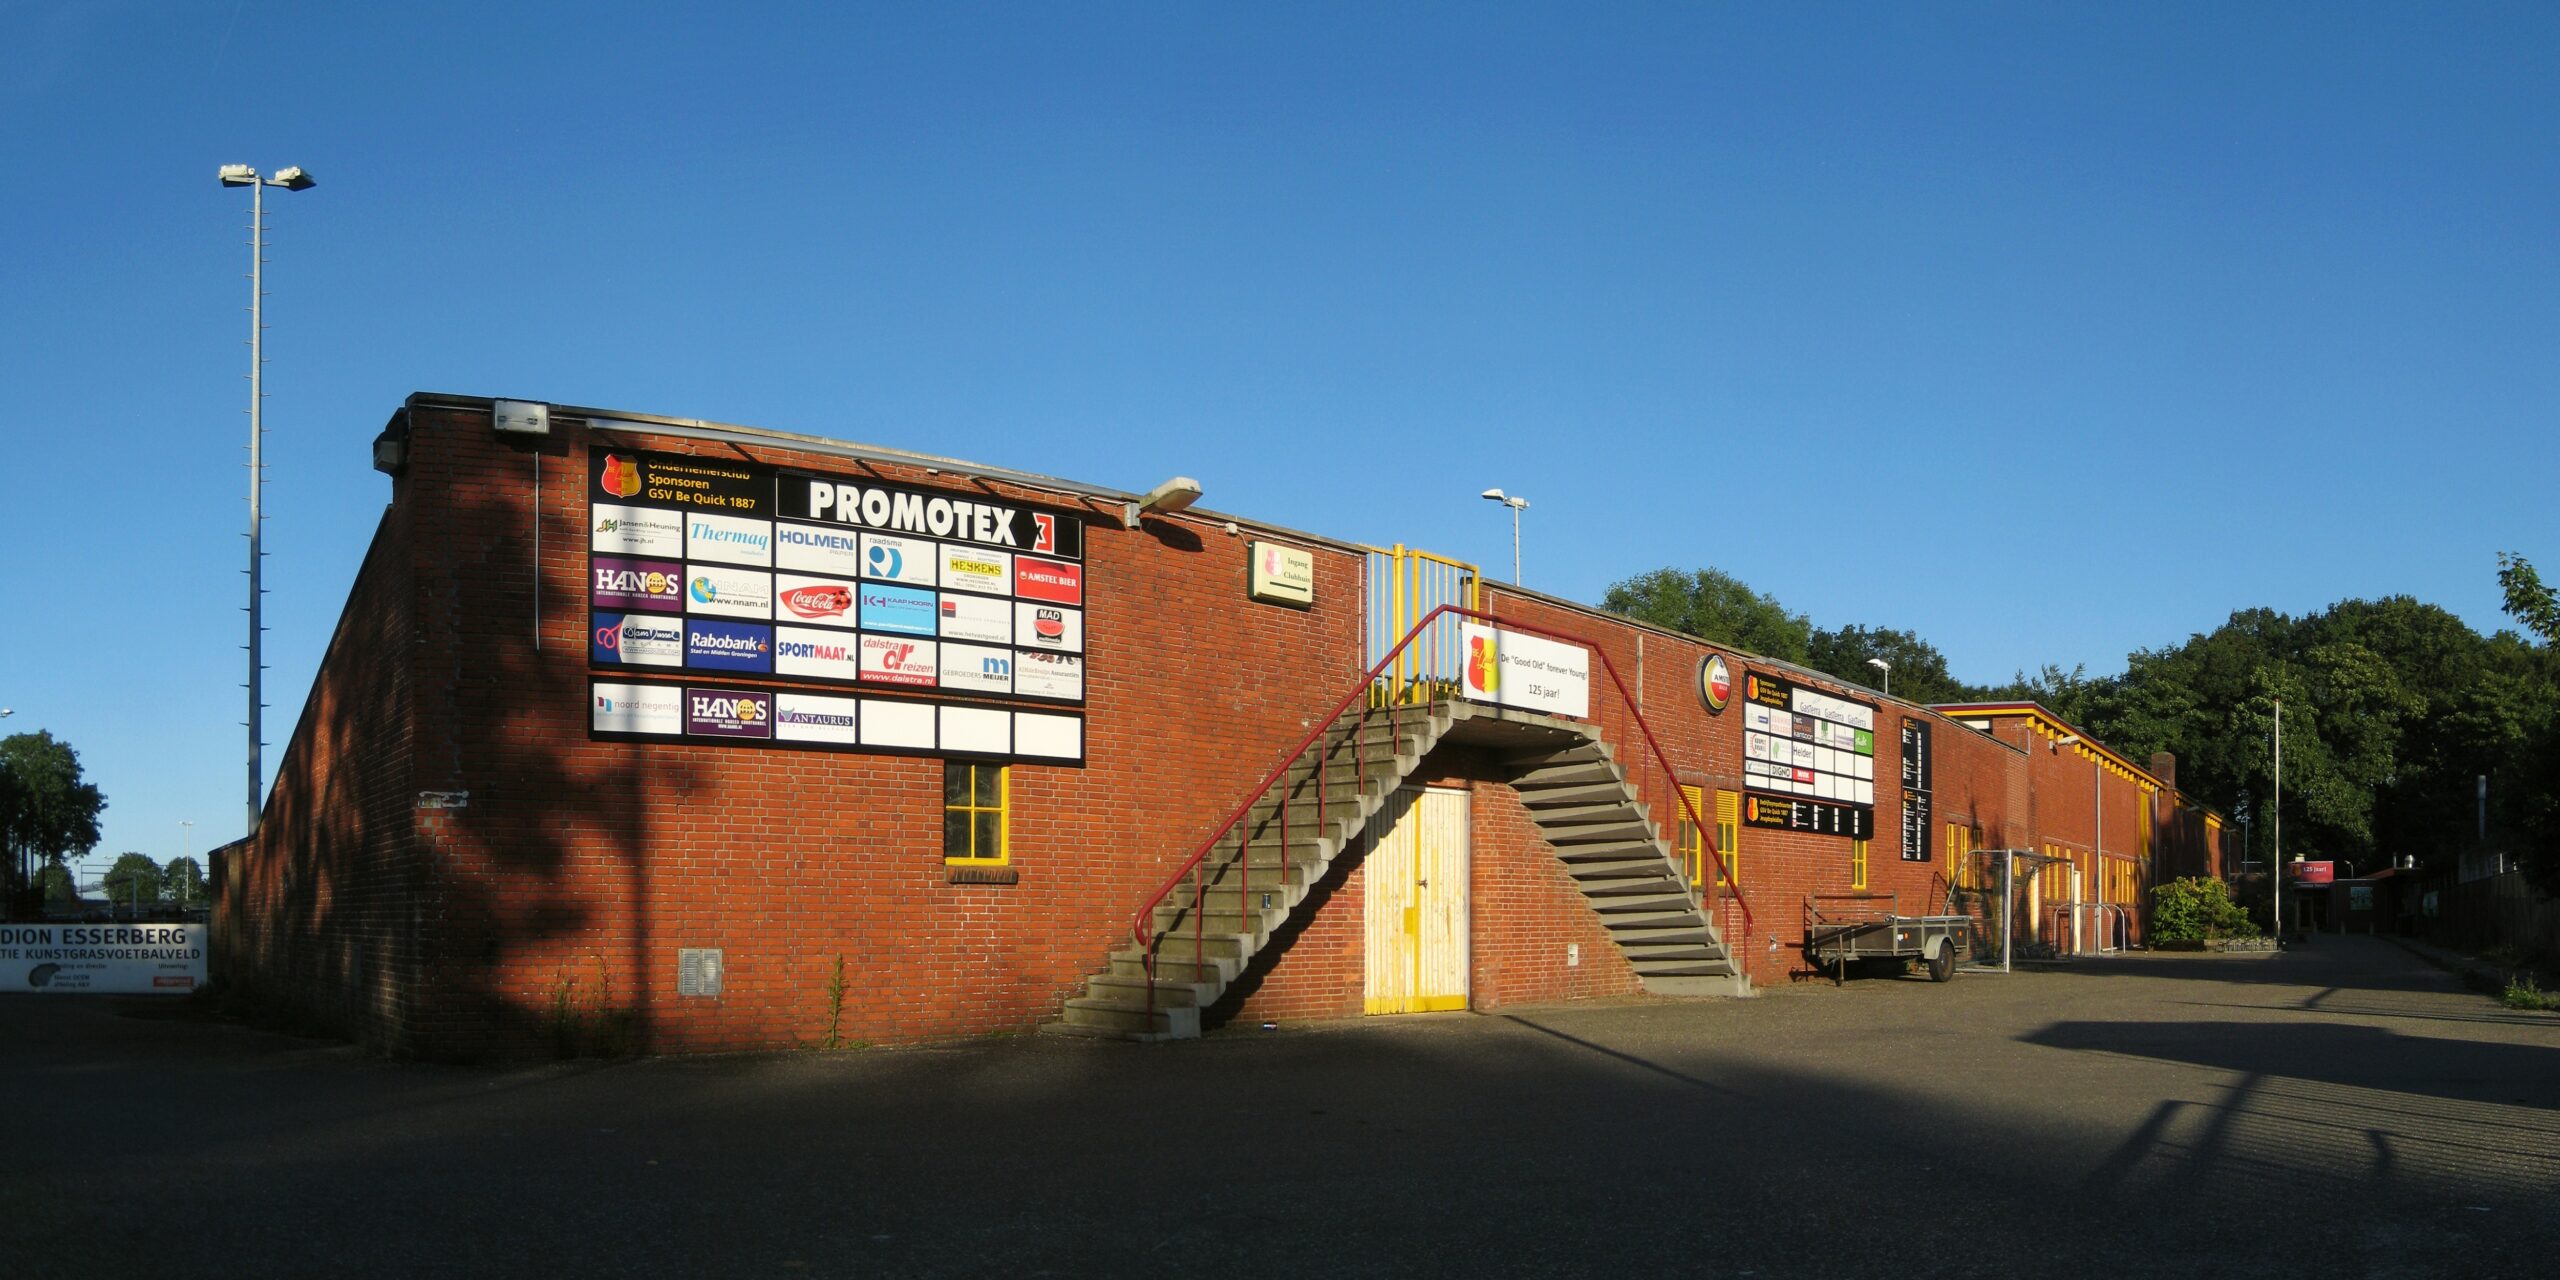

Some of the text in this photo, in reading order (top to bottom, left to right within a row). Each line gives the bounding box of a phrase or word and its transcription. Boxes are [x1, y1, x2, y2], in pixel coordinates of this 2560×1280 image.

[648, 473, 710, 490] Sponsoren
[648, 488, 756, 509] GSV Be Quick 1887
[809, 481, 1017, 546] PROMOTEX
[691, 522, 768, 550] Thermaq
[779, 530, 854, 550] HOLMEN
[869, 537, 902, 547] raadsma
[951, 559, 1001, 575] HEYKENS
[1287, 557, 1309, 569] Ingang
[595, 569, 679, 595] HANOS
[1027, 573, 1077, 587] AMSTEL BIER
[1283, 571, 1311, 583] Clubhuis
[709, 597, 769, 608] www.nnam.nl
[791, 590, 836, 610] Coca-Cola
[1038, 609, 1060, 620] MAD
[690, 632, 757, 651] Rabobank
[863, 638, 899, 650] dalstra
[731, 651, 757, 659] Groningen
[778, 642, 855, 662] SPORTMAAT.NL
[902, 662, 934, 673] reizen
[1501, 653, 1588, 680] De "Good Old" forever Young!
[863, 673, 933, 685] www.dalstra.nl
[942, 669, 981, 679] GEBROEDERS
[983, 674, 1009, 682] MEIJER
[1528, 684, 1560, 699] 125 jaar!
[614, 699, 680, 712] noord negentig
[692, 697, 767, 721] HANOS
[1771, 766, 1791, 779] DIGNO
[1, 928, 187, 945] DION ESSERBERG
[0, 949, 200, 960] TIE KUNSTGRASVOETBALVELD
